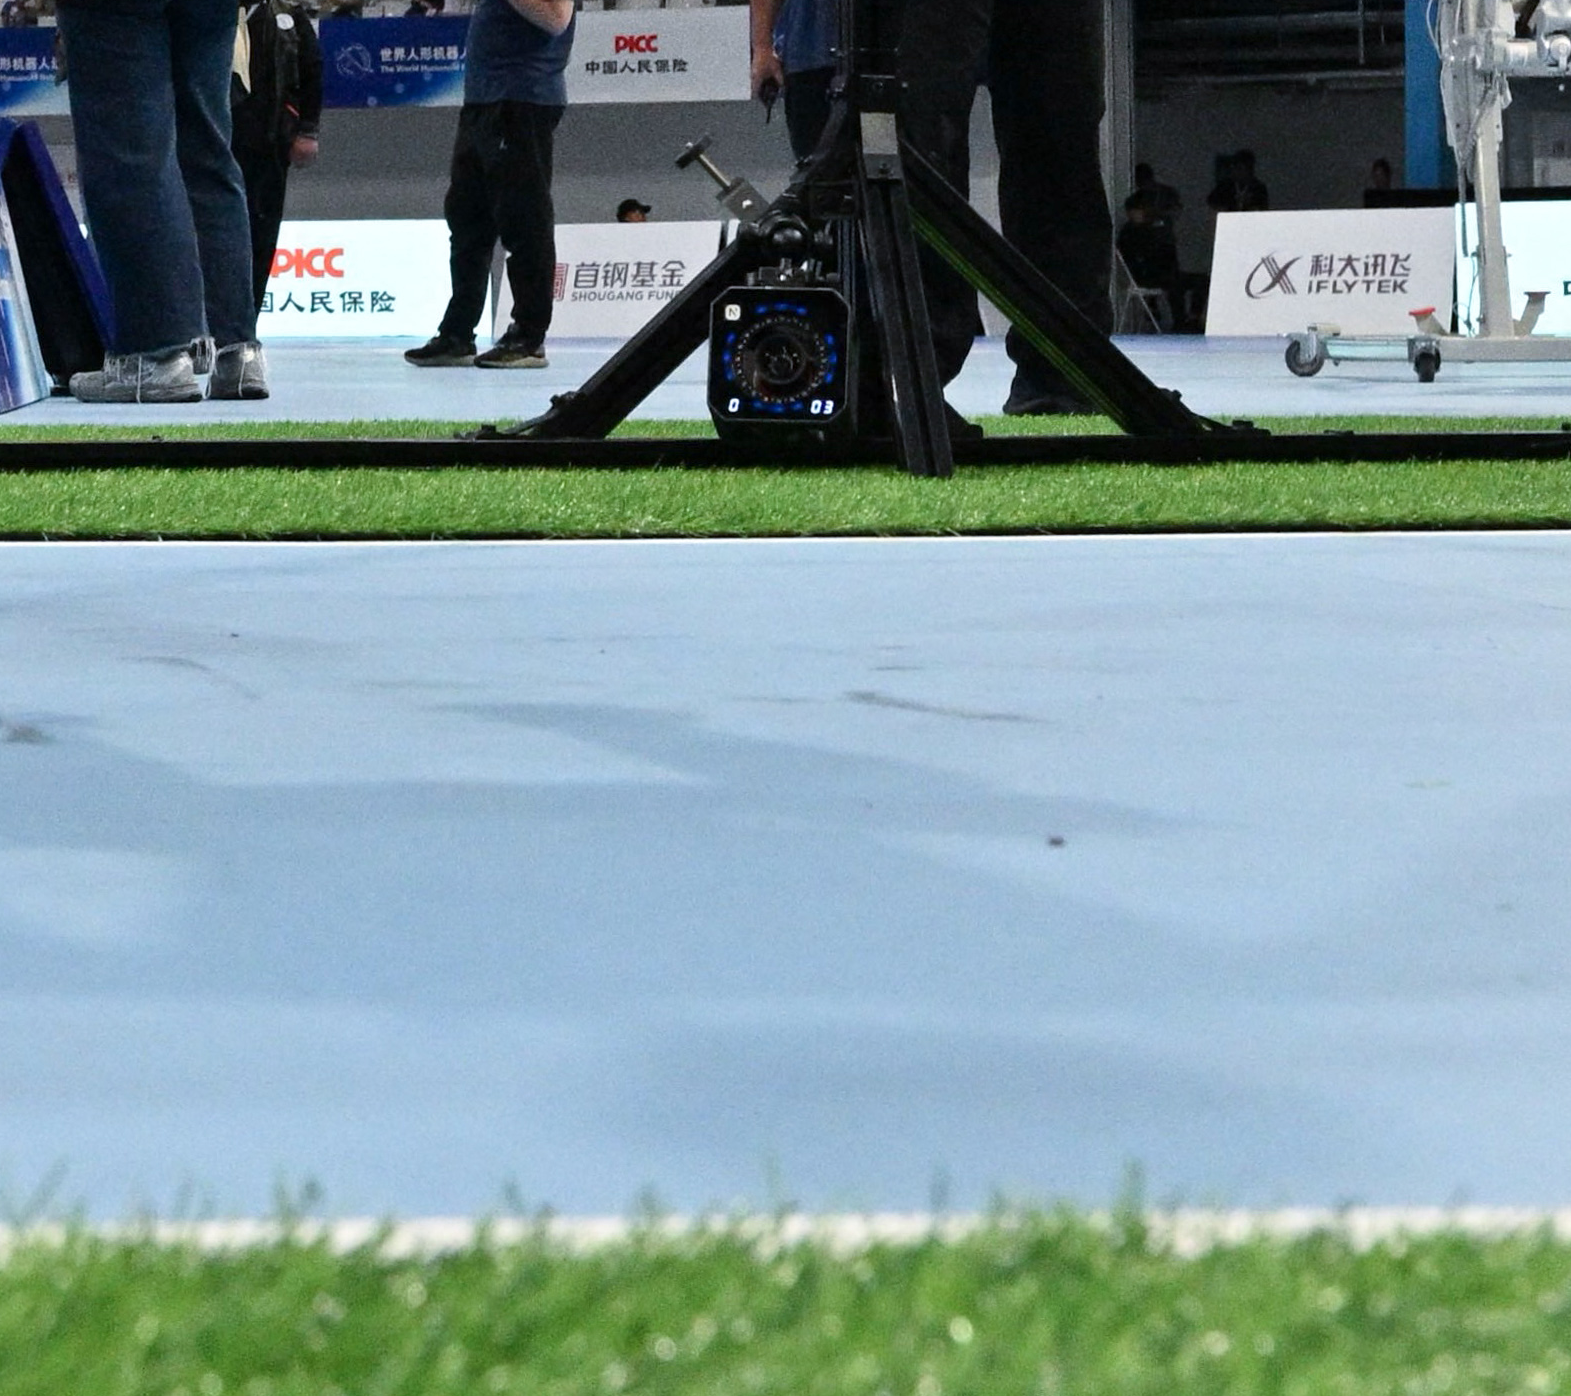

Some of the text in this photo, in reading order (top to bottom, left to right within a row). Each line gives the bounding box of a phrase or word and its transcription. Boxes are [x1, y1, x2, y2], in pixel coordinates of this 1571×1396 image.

[614, 34, 659, 54] PICC
[270, 247, 345, 278] PICC
[1310, 253, 1412, 278] 科大讯飞
[573, 260, 686, 289] 首钢基金
[571, 290, 644, 302] SHOUGANG
[810, 399, 835, 415] 03
